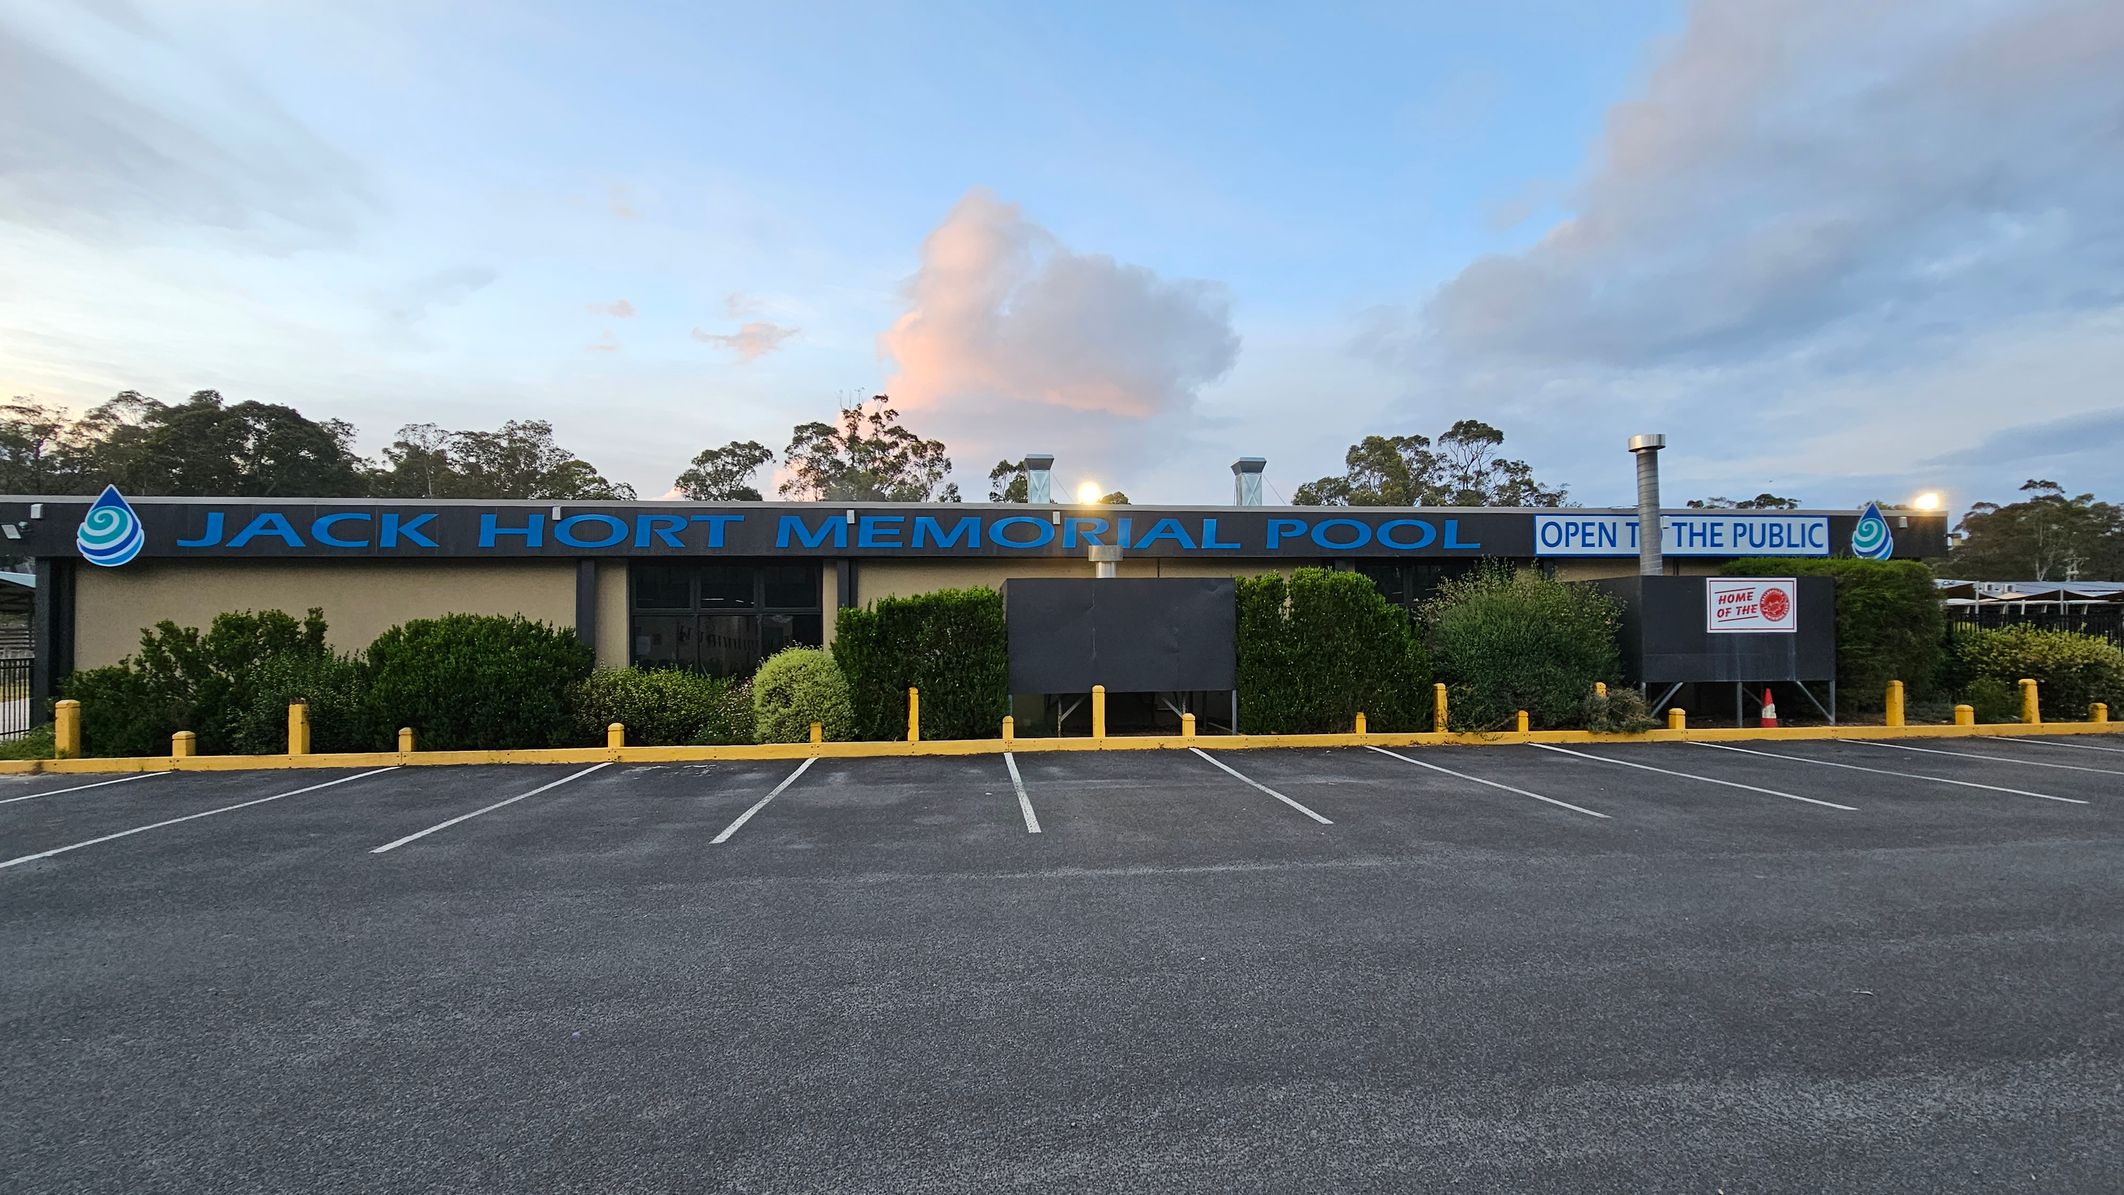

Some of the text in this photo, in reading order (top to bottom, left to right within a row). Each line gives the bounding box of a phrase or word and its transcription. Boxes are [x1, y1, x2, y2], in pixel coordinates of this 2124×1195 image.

[177, 512, 1480, 550] JACK HORT MEMORIAL POOL
[1541, 521, 1617, 548] OPEN
[1672, 522, 1724, 548] THE
[1733, 522, 1824, 549] PUBLIC
[1718, 592, 1754, 605] HOME
[1717, 604, 1758, 618] OF THE
